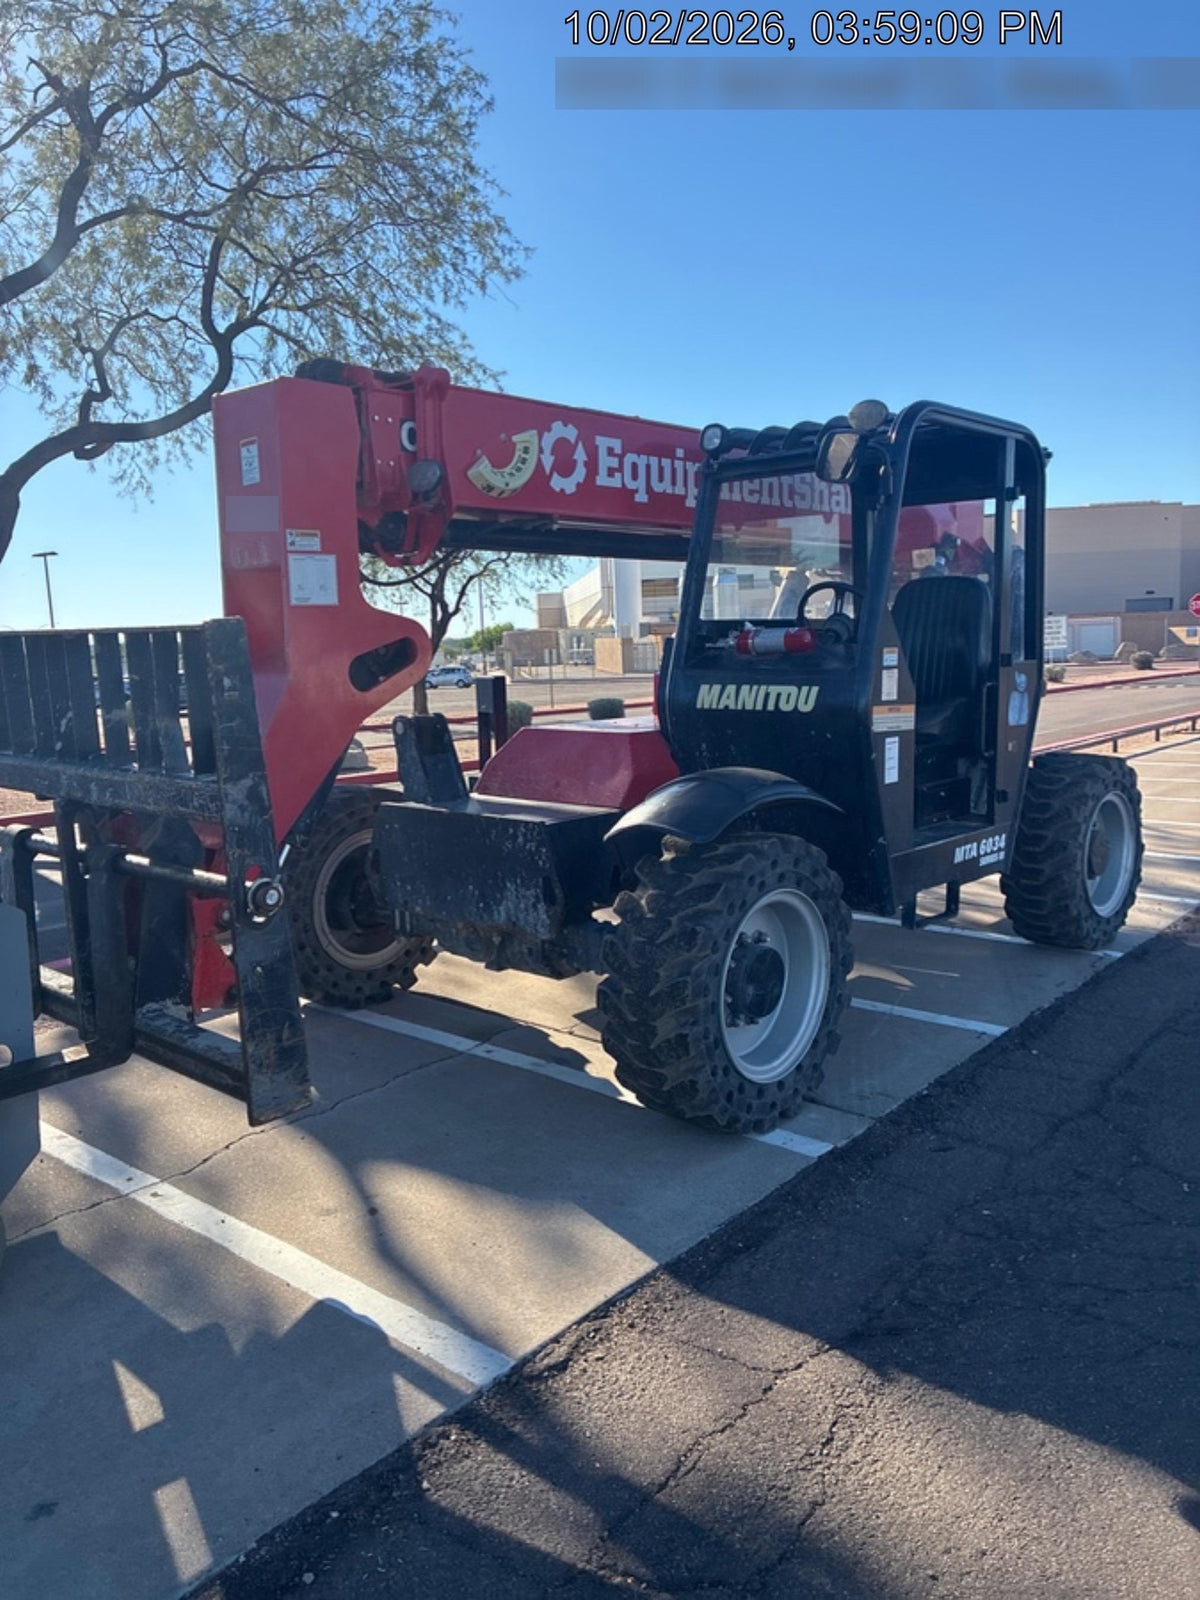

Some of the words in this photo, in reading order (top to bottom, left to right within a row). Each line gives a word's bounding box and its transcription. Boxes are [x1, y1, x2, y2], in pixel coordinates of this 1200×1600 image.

[696, 684, 820, 713] MANITOU
[953, 841, 978, 865] MTA
[979, 833, 1007, 856] 6034
